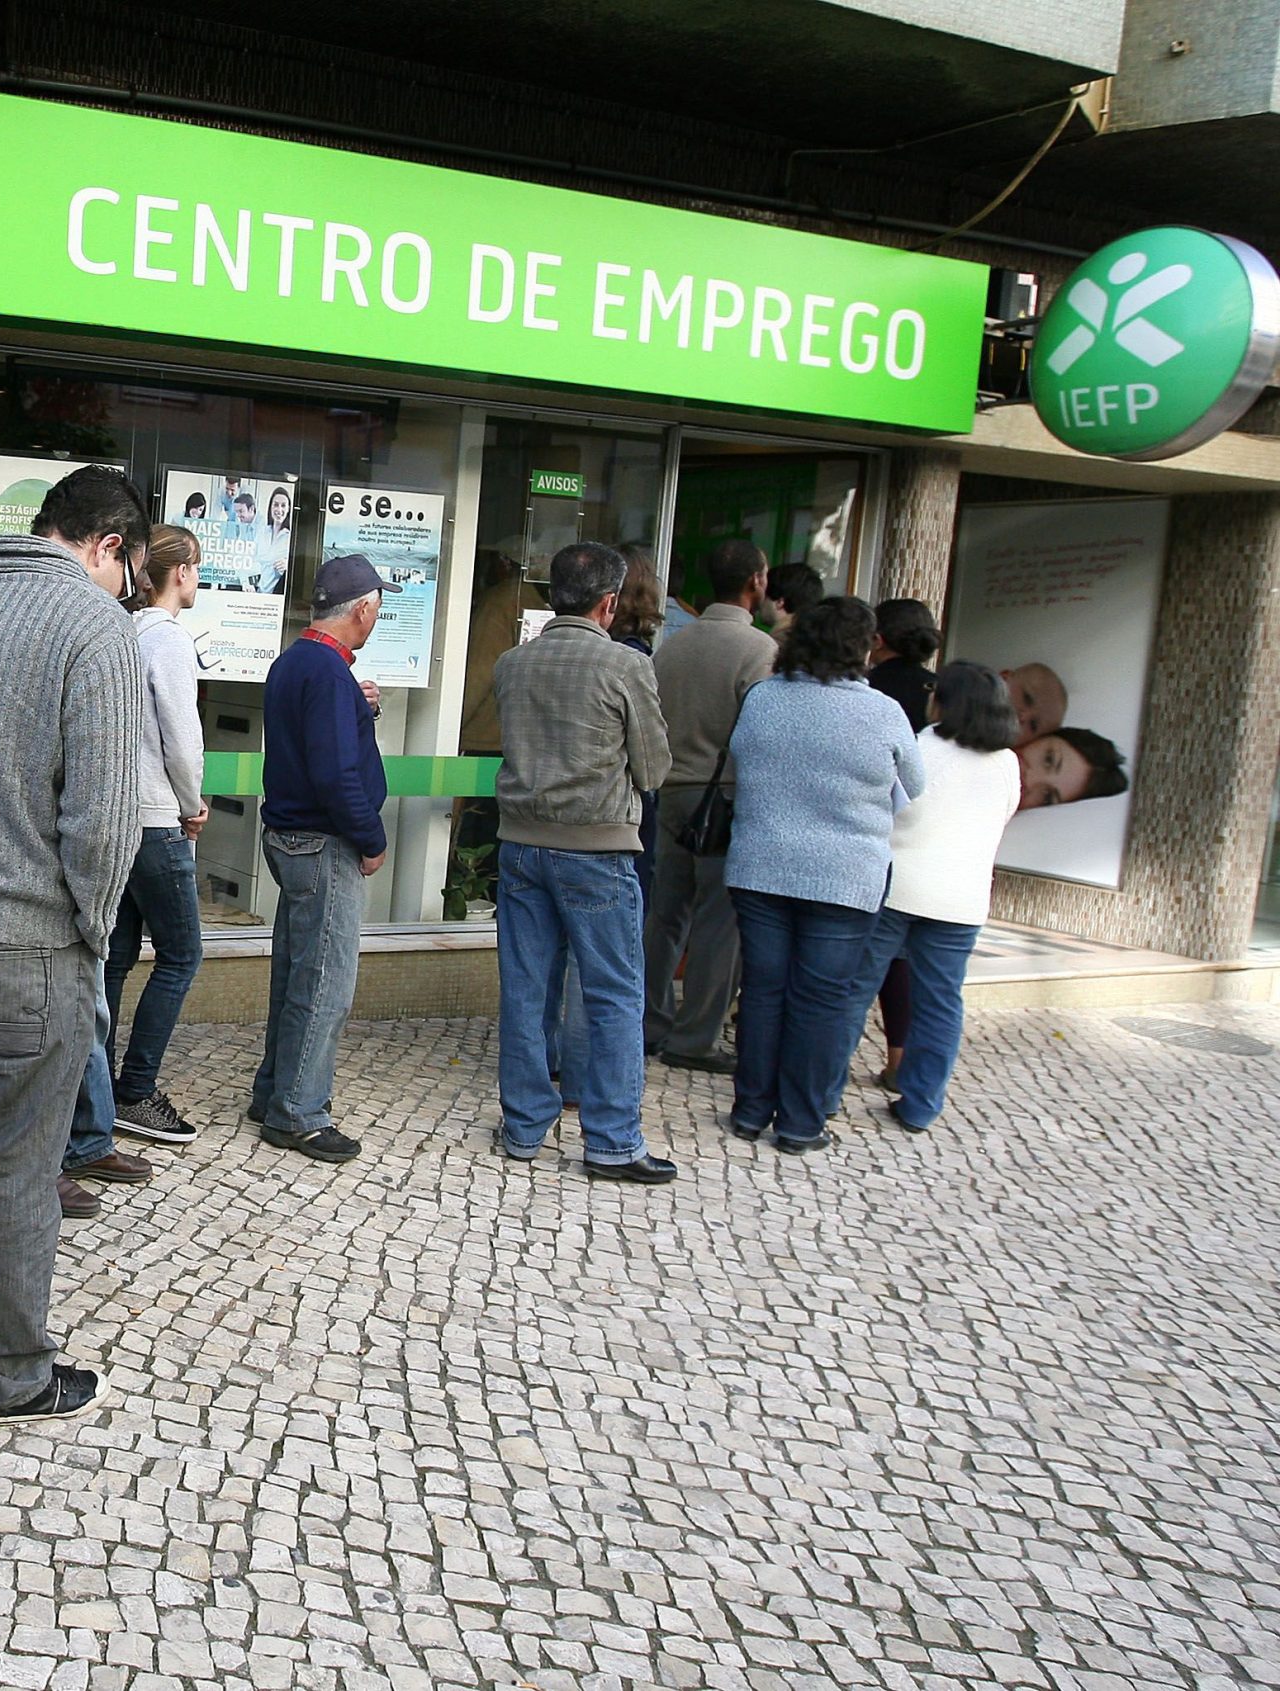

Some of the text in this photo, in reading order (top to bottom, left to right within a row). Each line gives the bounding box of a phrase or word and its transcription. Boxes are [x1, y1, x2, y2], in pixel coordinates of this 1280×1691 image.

[67, 186, 926, 381] CENTRO DE EMPREGO
[1059, 383, 1160, 429] IEFP
[537, 475, 579, 492] AVISOS
[328, 492, 425, 522] e se...
[184, 520, 222, 537] MAIS
[199, 552, 252, 570] PREGO
